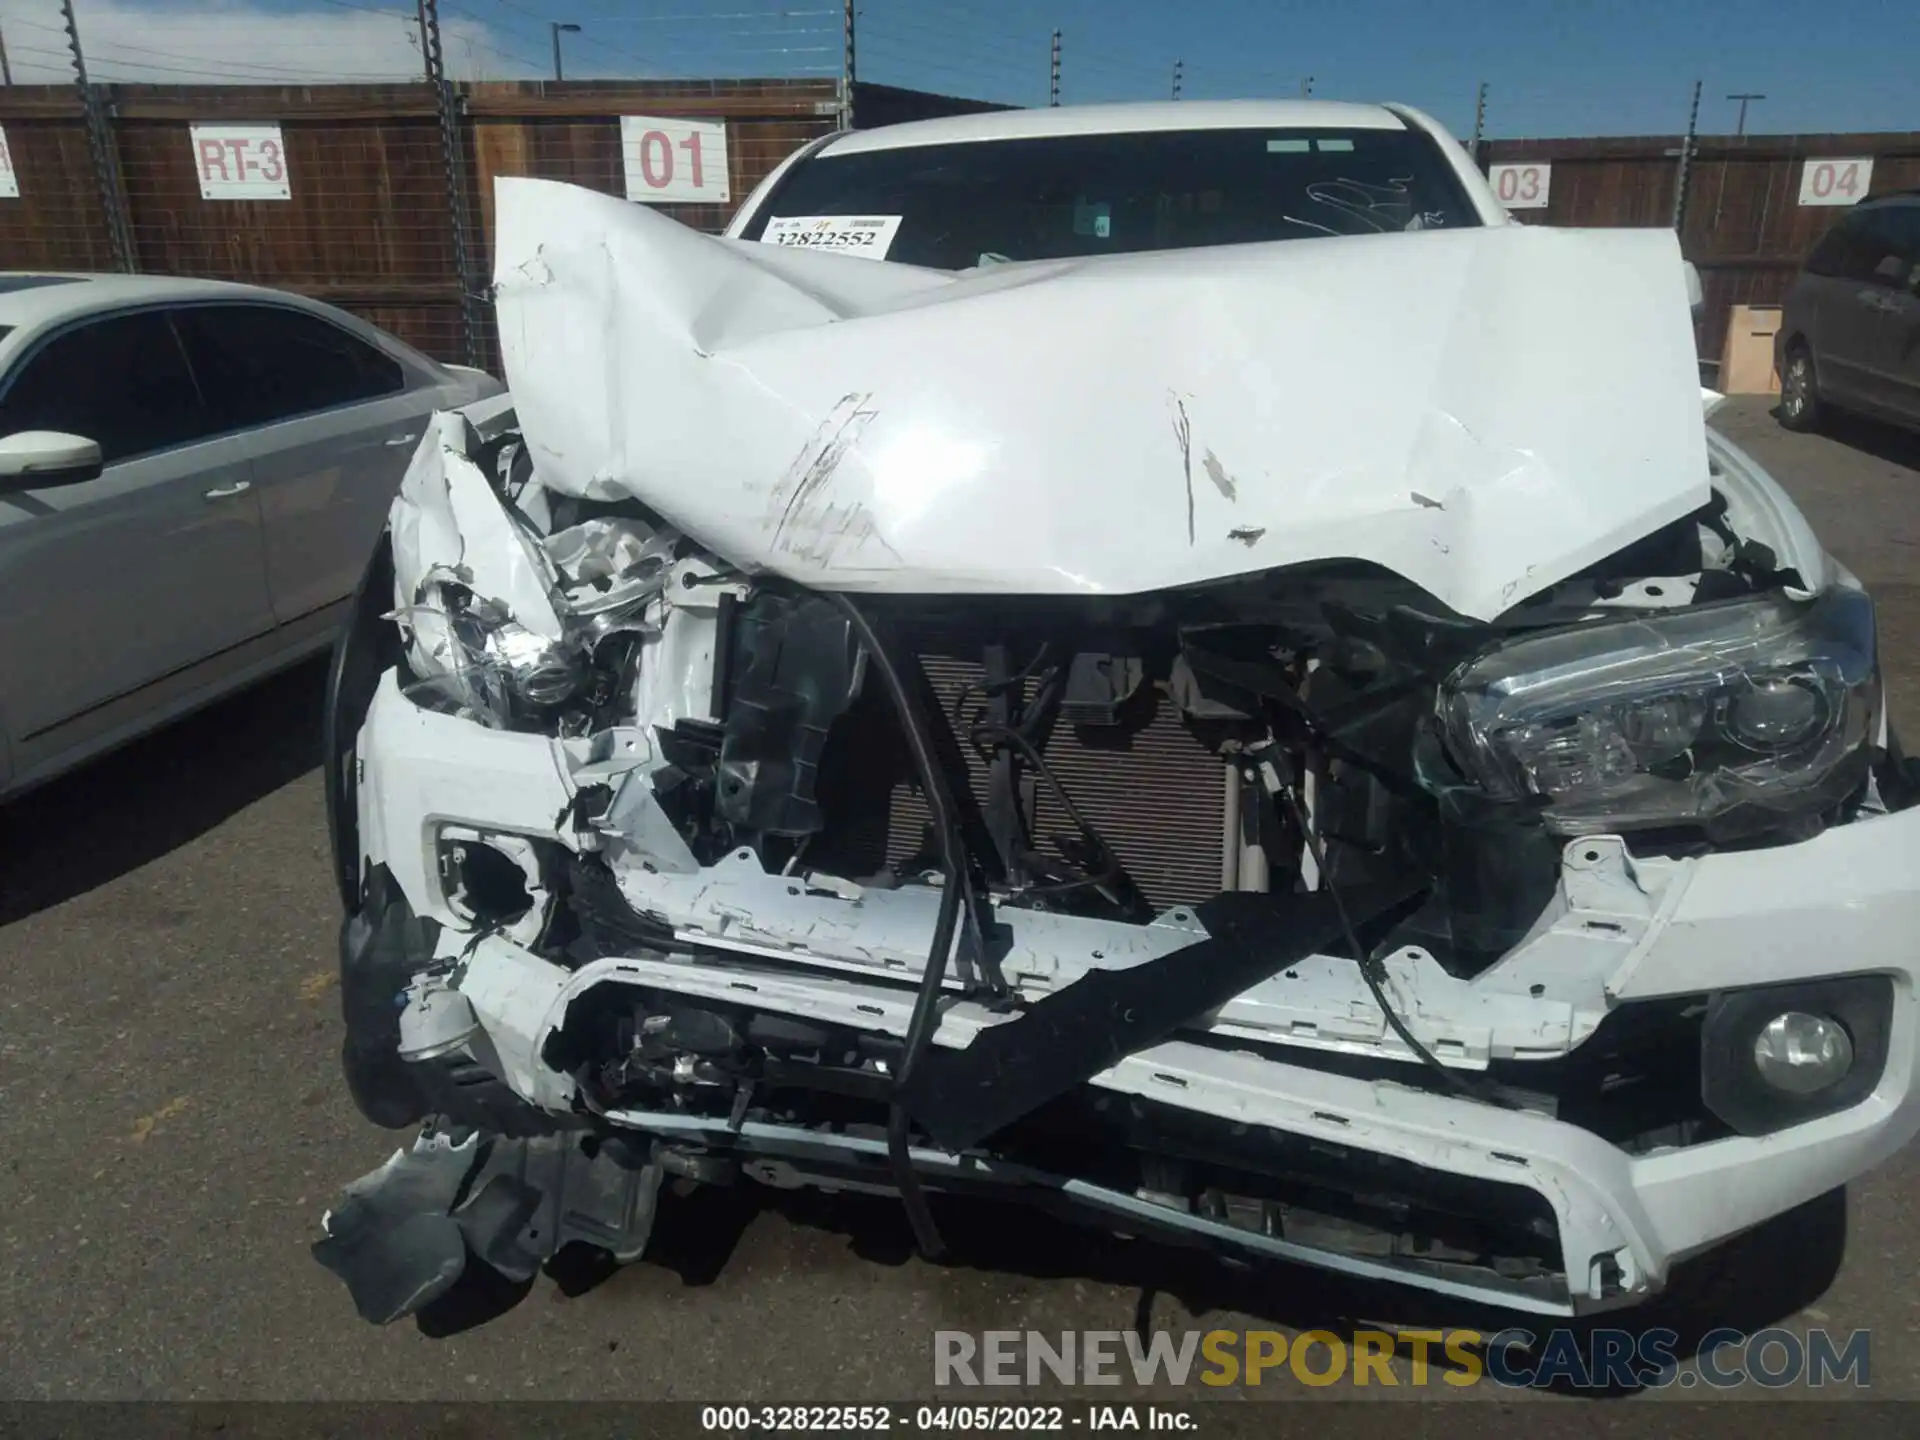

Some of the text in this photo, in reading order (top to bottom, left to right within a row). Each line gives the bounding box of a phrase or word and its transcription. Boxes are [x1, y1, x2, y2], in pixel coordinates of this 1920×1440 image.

[198, 138, 285, 182] RT-3
[640, 131, 705, 188] 01
[1498, 168, 1540, 202] 03
[1811, 164, 1860, 198] 04
[776, 231, 877, 246] 32822552
